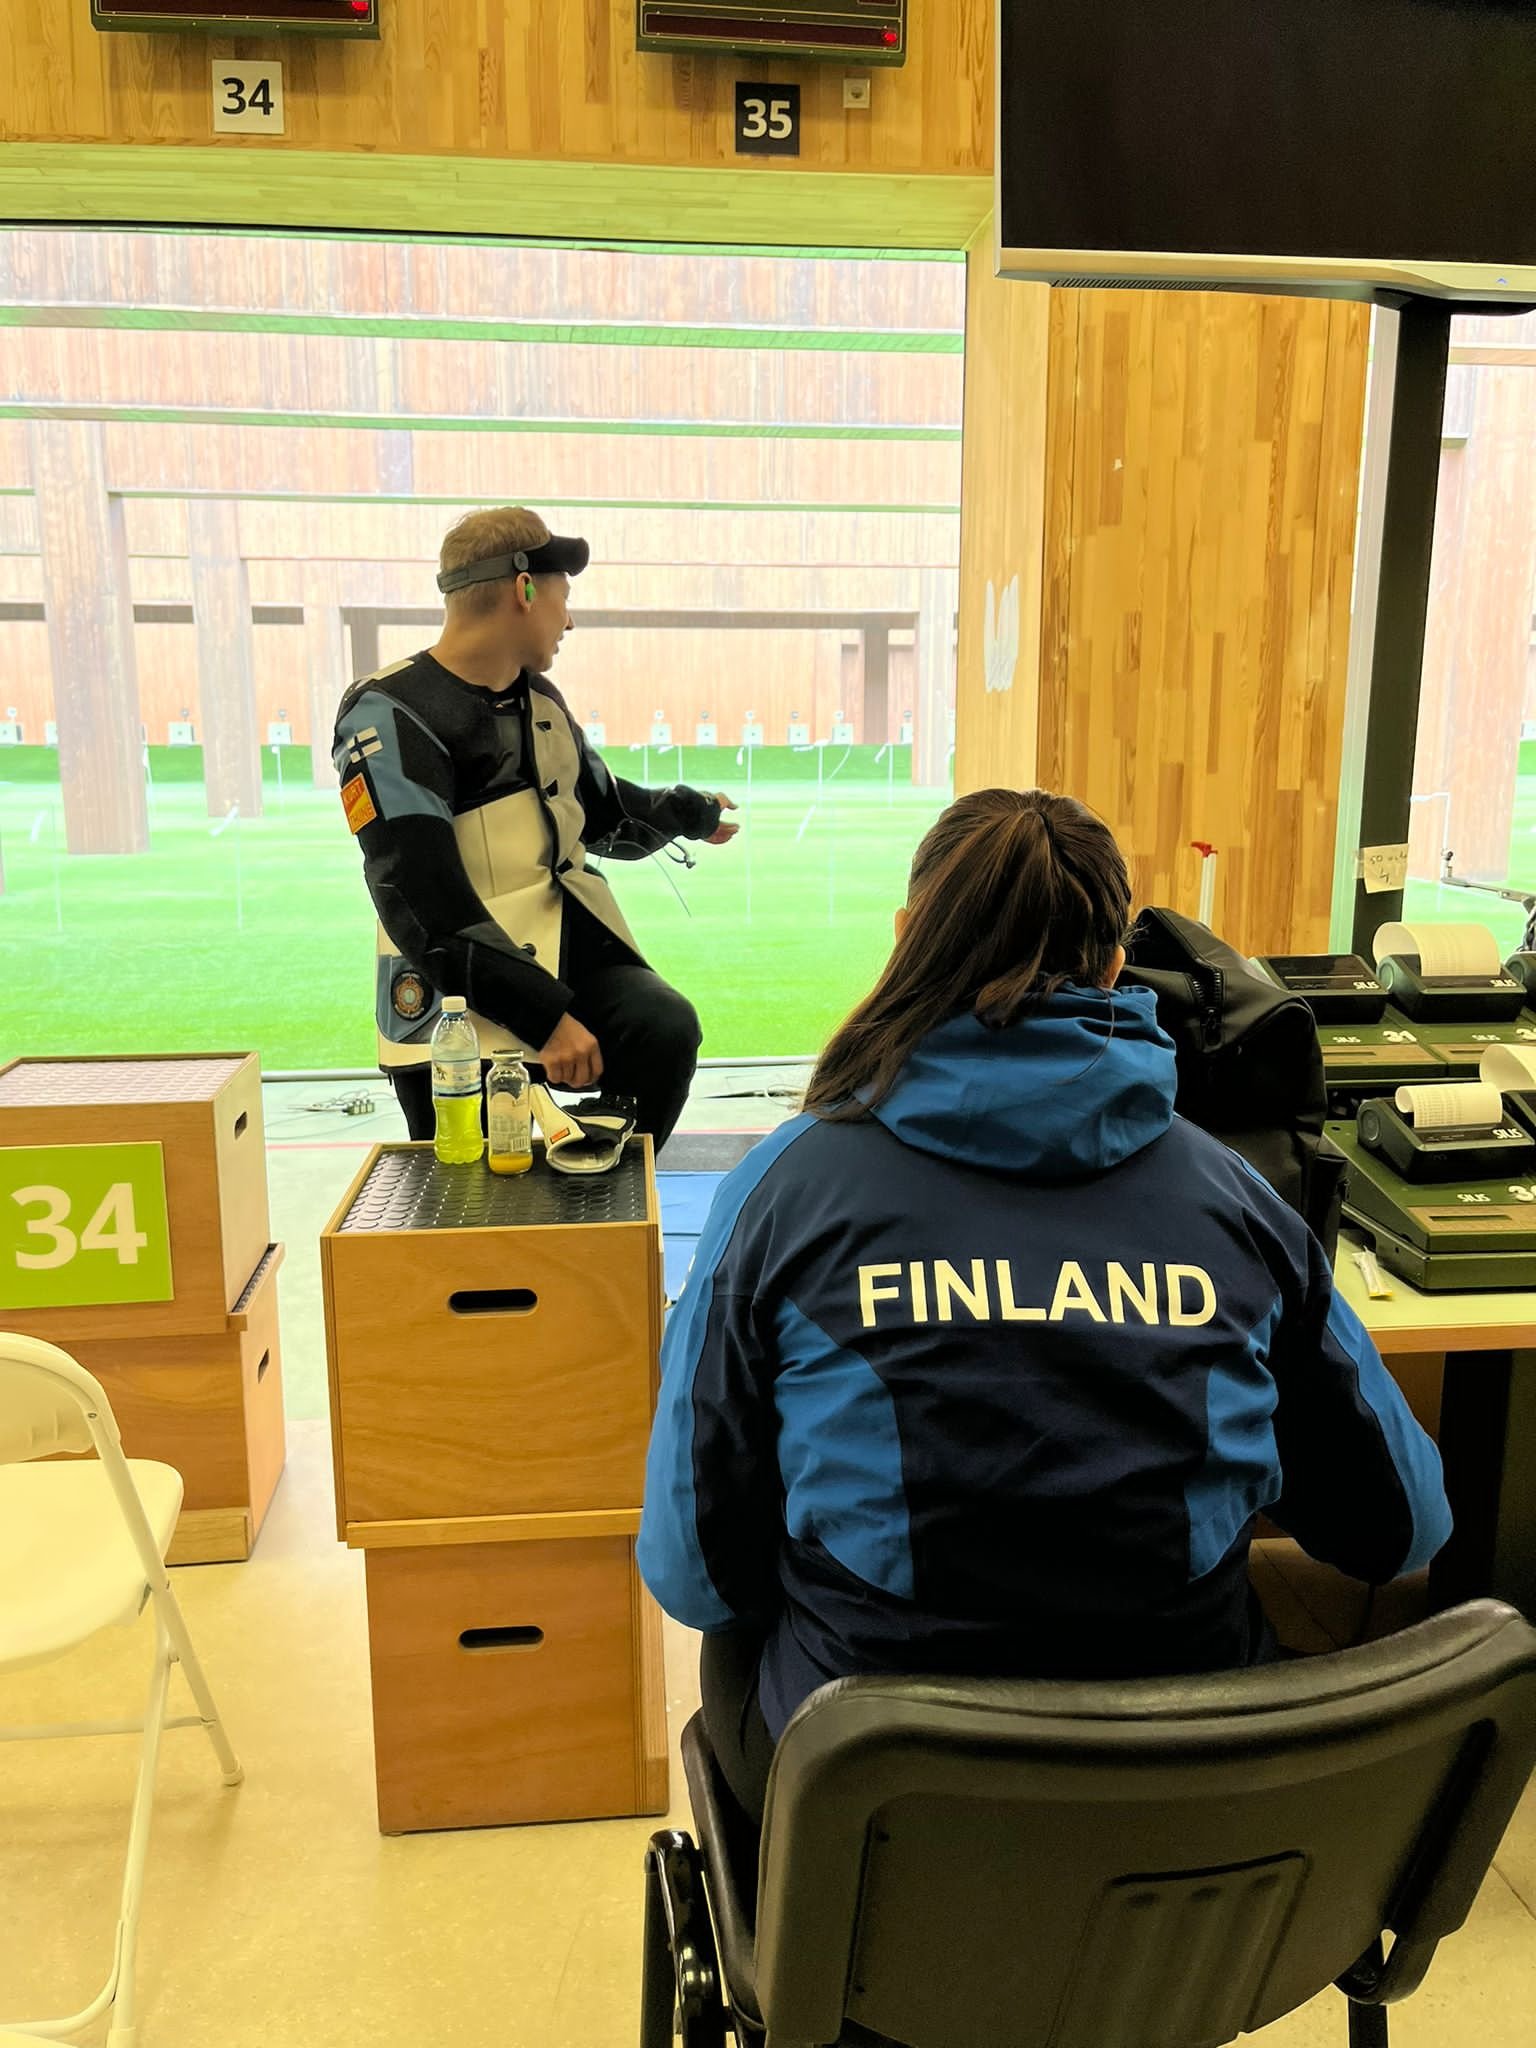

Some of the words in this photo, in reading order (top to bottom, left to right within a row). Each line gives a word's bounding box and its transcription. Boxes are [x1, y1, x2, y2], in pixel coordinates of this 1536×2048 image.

[222, 77, 274, 115] 34
[743, 98, 792, 138] 35
[1382, 1030, 1417, 1043] 31
[1508, 1185, 1536, 1202] 3
[10, 1182, 148, 1270] 34
[858, 1258, 1217, 1327] FINLAND
